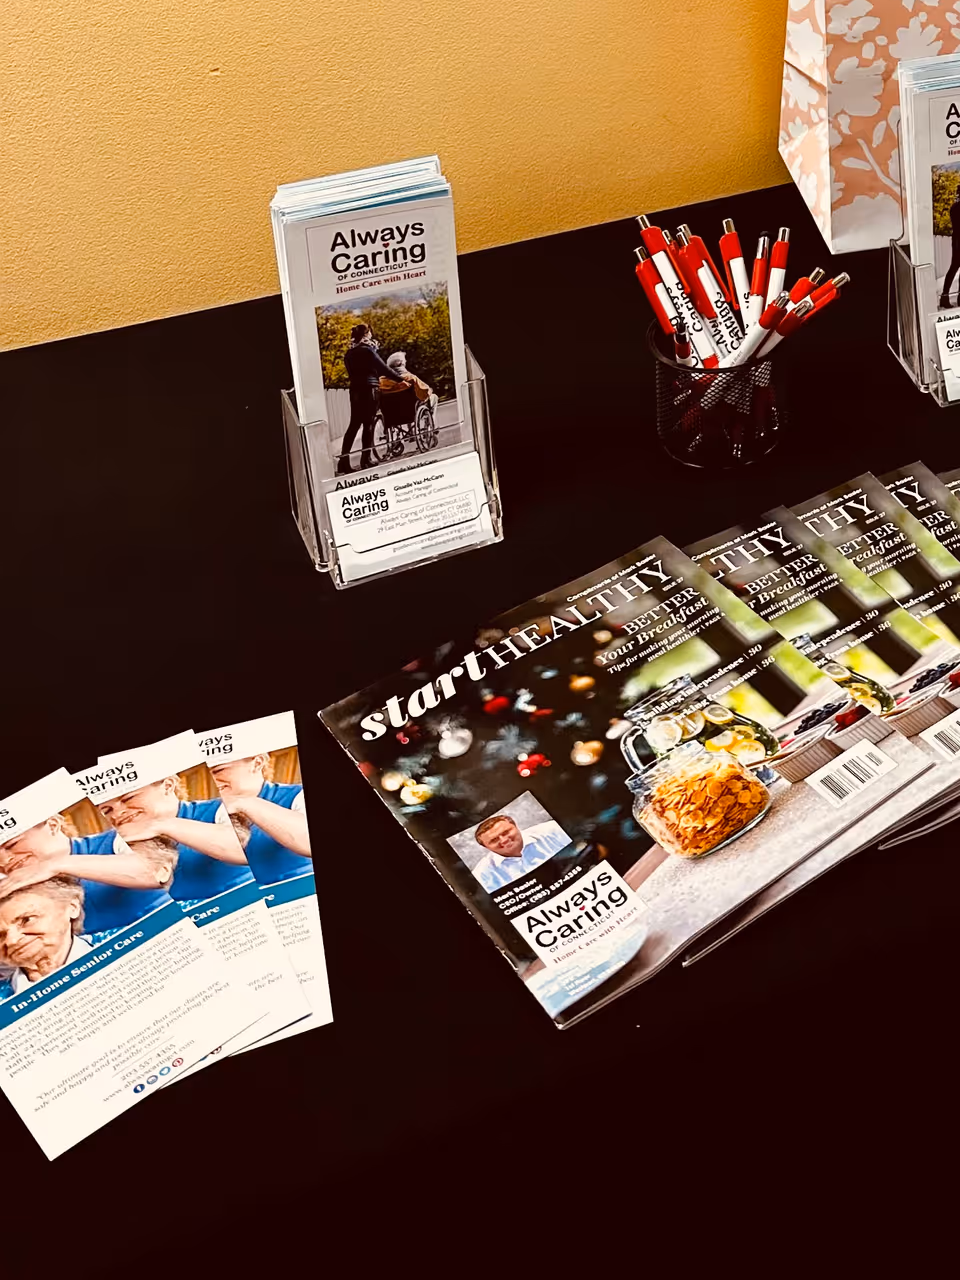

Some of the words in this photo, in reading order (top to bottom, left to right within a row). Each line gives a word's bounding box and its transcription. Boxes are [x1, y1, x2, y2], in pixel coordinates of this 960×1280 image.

[330, 221, 425, 253] Always
[330, 241, 427, 274] Caring
[337, 272, 349, 281] OF
[350, 261, 409, 279] CONNECTICUT
[335, 283, 360, 295] Home
[361, 277, 382, 289] Care
[383, 273, 402, 285] with
[403, 270, 427, 282] Heart
[341, 487, 387, 509] Always
[341, 497, 390, 521] Caring
[884, 542, 917, 561] morning
[567, 578, 612, 603] Compliments
[611, 573, 619, 581] of
[618, 565, 637, 577] Mark
[743, 553, 819, 595] BETTER
[757, 562, 828, 605] Breakfast
[939, 581, 953, 592] 30
[759, 599, 789, 617] making
[805, 572, 839, 593] morning
[621, 586, 701, 635] BETTER
[865, 609, 879, 622] 30
[920, 601, 946, 620] home
[596, 640, 635, 666] Your
[636, 596, 709, 647] Breakfast
[624, 654, 639, 670] for
[639, 638, 669, 658] making
[668, 627, 687, 645] your
[686, 606, 720, 629] morning
[647, 646, 667, 663] meal
[666, 627, 701, 651] healthier
[847, 630, 874, 651] home
[878, 620, 892, 632] 36
[748, 643, 763, 657] 30
[707, 684, 733, 702] from
[732, 667, 758, 688] home
[761, 655, 776, 668] 36
[76, 760, 135, 787] Always
[82, 769, 139, 796] aring
[493, 890, 514, 904] Mark
[498, 883, 543, 910] CEO/Owner
[504, 900, 530, 916] Office:
[526, 871, 613, 934] Always
[190, 903, 220, 924] Care
[535, 885, 629, 949] Caring
[562, 909, 616, 947] CONNECTICUT
[552, 948, 577, 965] Home
[577, 936, 598, 951] Care
[598, 924, 617, 939] with
[615, 905, 639, 926] Heart
[11, 974, 71, 1014] In-Home
[70, 947, 114, 978] Senior
[113, 929, 145, 952] Care
